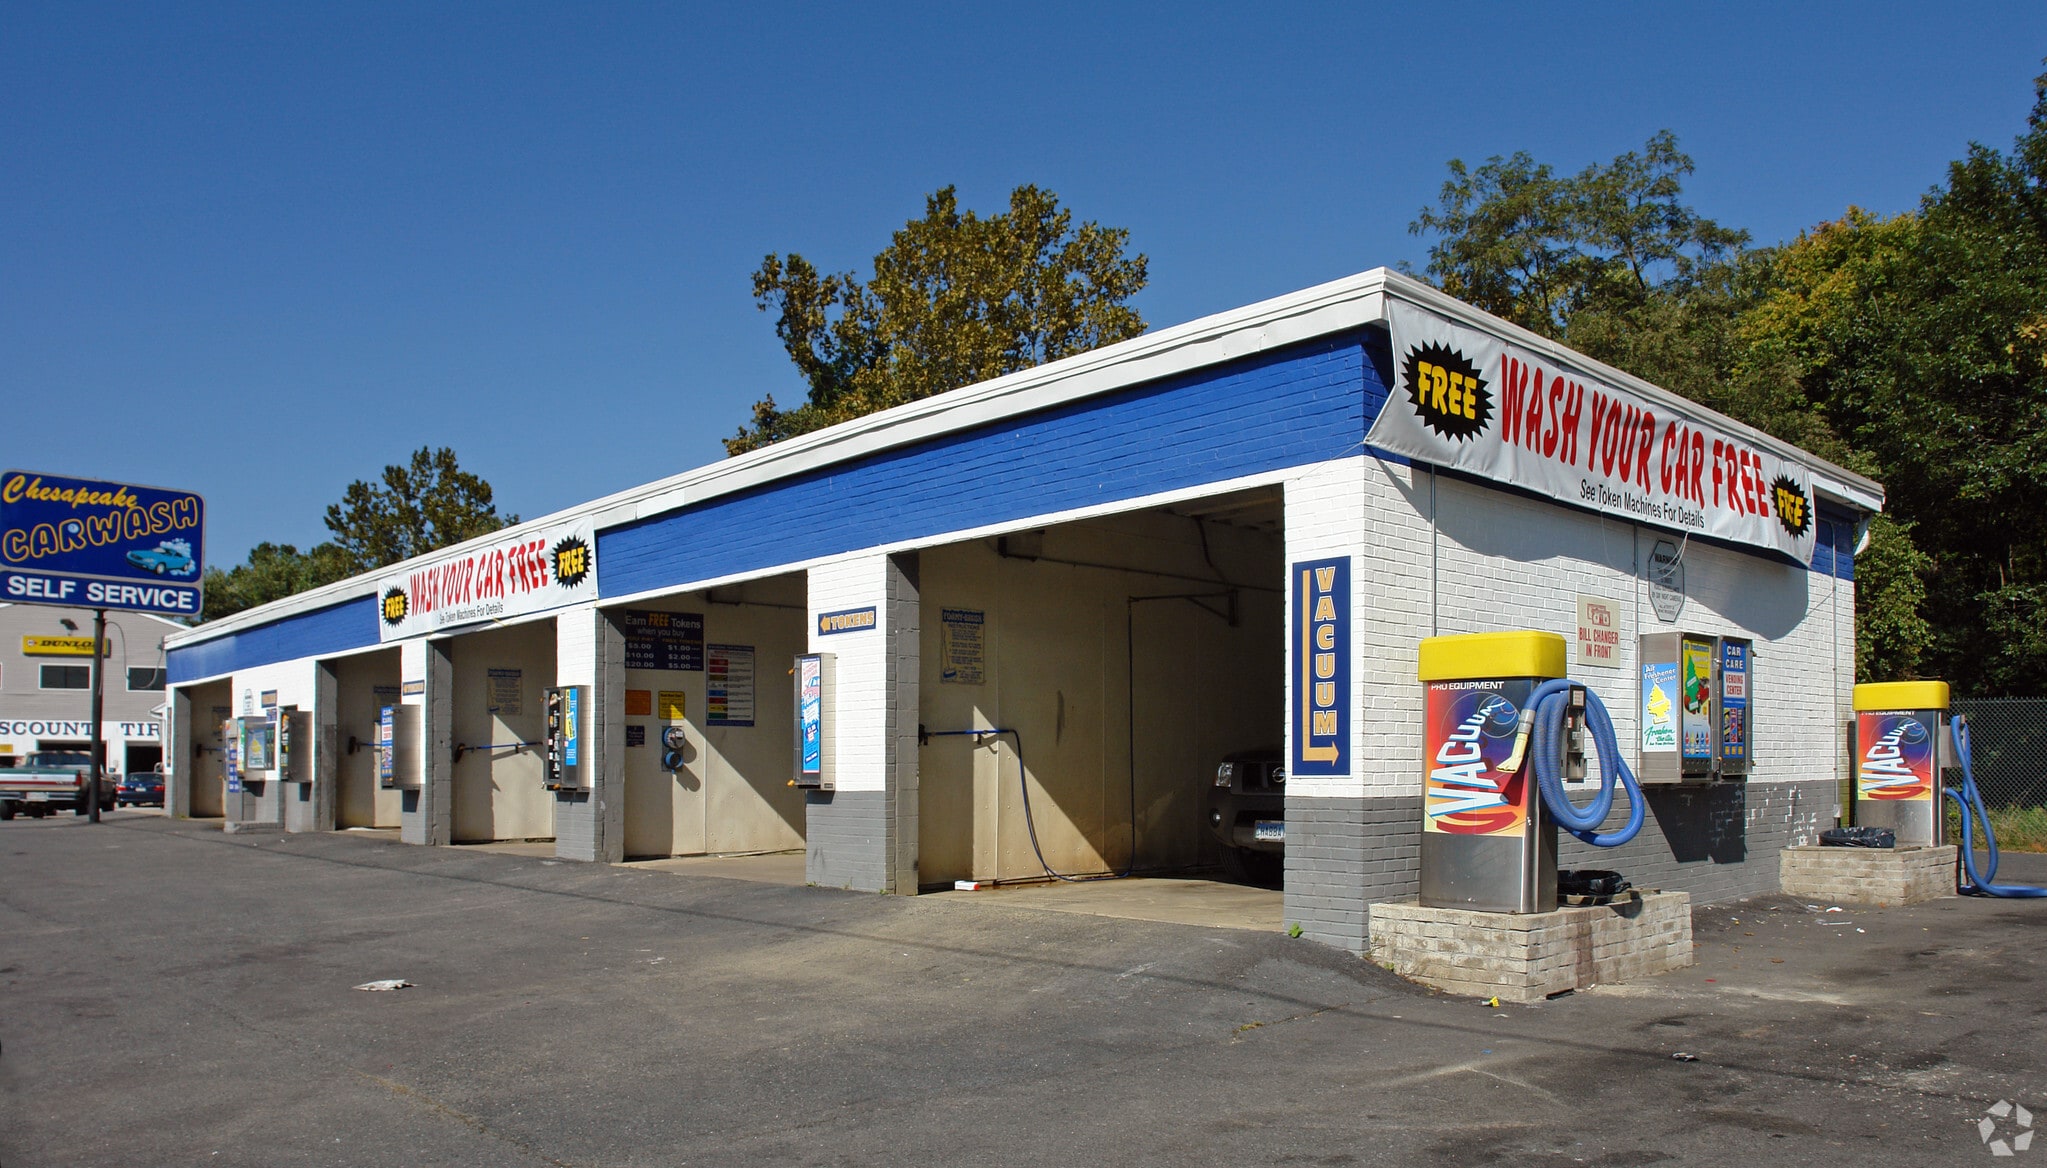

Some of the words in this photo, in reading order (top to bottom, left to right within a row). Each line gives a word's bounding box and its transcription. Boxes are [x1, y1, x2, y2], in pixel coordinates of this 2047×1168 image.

[1418, 361, 1477, 420] FREE
[1501, 353, 1584, 466] WASH
[1587, 391, 1655, 495] YOUR
[1661, 417, 1705, 510] CAR
[1712, 440, 1769, 517] FREE
[3, 475, 137, 508] Chesapeake
[1581, 479, 1595, 501] See
[1599, 485, 1621, 508] Token
[1624, 492, 1661, 520] Machines
[1664, 502, 1676, 520] For
[1678, 507, 1704, 528] Details
[1776, 488, 1803, 526] FREE
[559, 547, 584, 577] FREE
[410, 567, 440, 616] WASH
[441, 557, 473, 605] YOUR
[476, 549, 505, 600] CAR
[508, 539, 548, 594] FREE
[8, 575, 76, 598] SELF
[86, 582, 193, 609] SERVICE
[385, 596, 404, 618] FREE
[456, 608, 476, 622] Machines
[476, 605, 485, 617] For
[486, 601, 504, 616] Details
[648, 613, 669, 627] FREE
[671, 618, 701, 629] Tokens
[831, 610, 874, 631] TOKENS
[637, 627, 656, 635] when
[658, 629, 671, 637] you
[672, 629, 685, 638] buy
[1579, 627, 1591, 641] BILL
[1594, 629, 1619, 645] CHANGER
[40, 640, 95, 648] DUNLO
[1314, 566, 1337, 735] VACUUM
[1586, 644, 1592, 656] IN
[1594, 644, 1612, 659] FRONT
[1726, 646, 1741, 656] CAR
[1645, 664, 1655, 672] Air
[1725, 659, 1743, 669] CARE
[1644, 668, 1676, 680] Freshener
[1655, 675, 1676, 684] Center
[1726, 674, 1743, 684] VENDING
[1449, 681, 1504, 690] EQUIPMENT
[1726, 685, 1742, 695] CENTER
